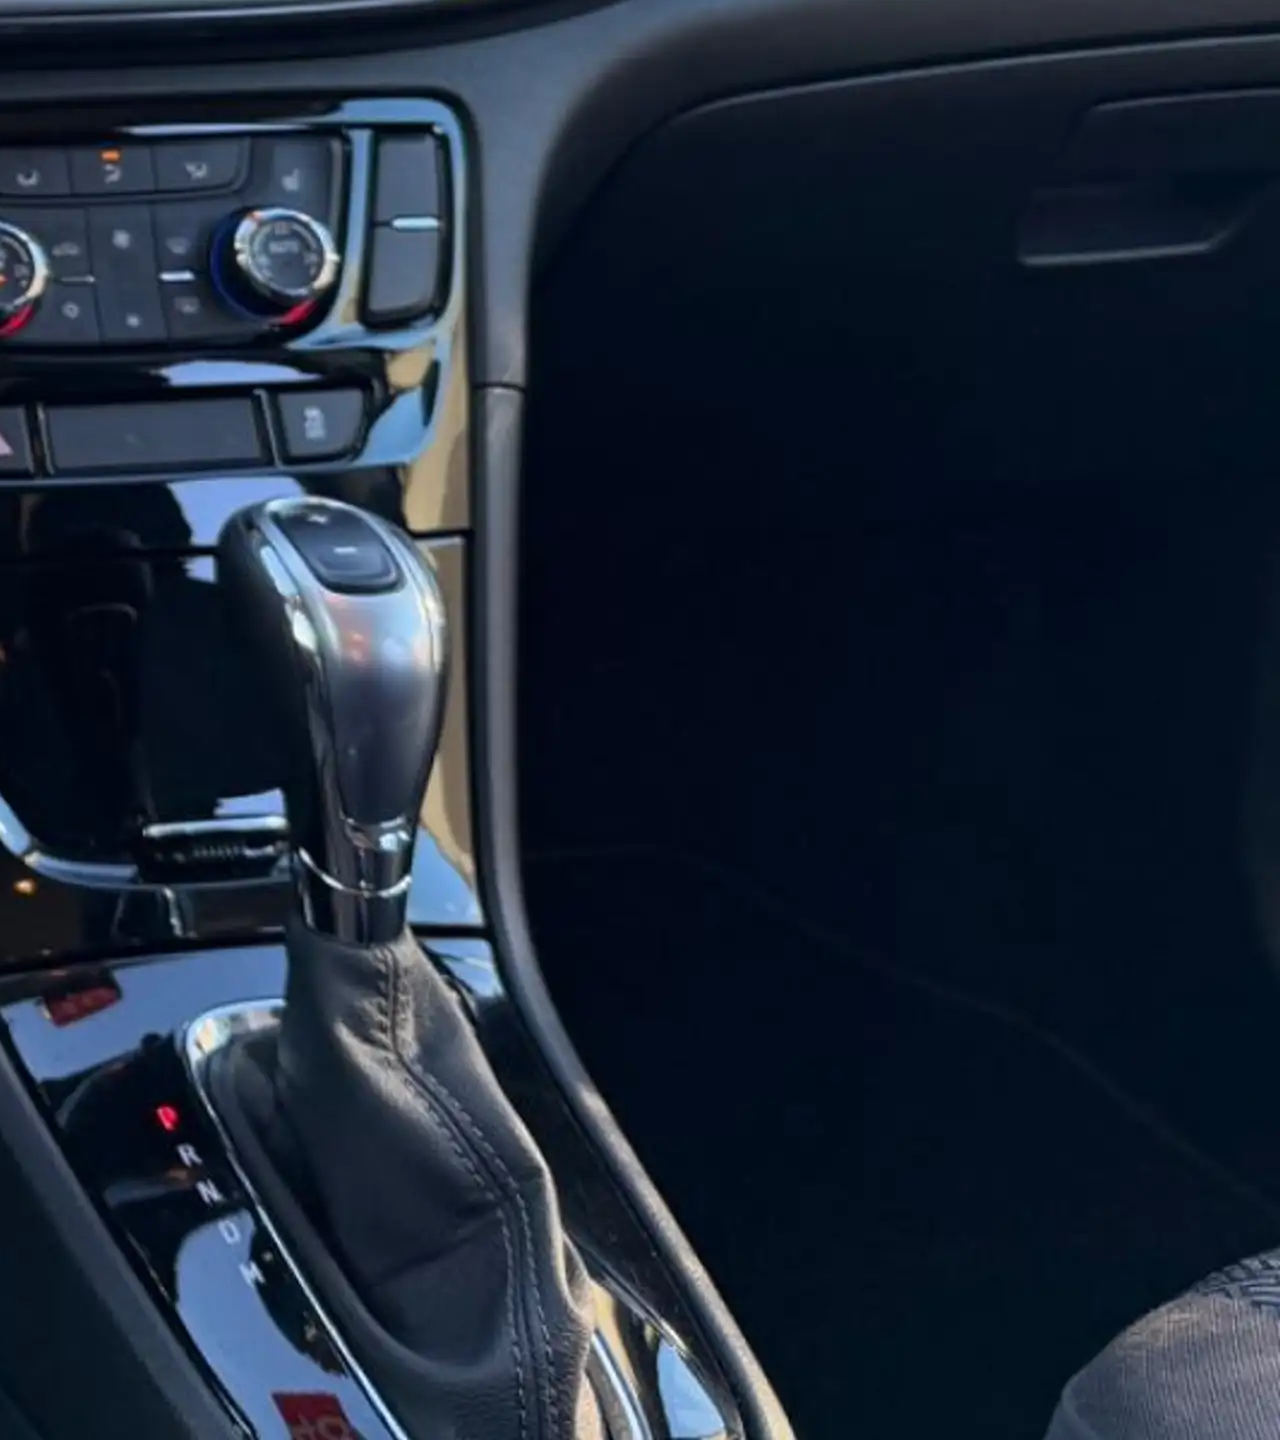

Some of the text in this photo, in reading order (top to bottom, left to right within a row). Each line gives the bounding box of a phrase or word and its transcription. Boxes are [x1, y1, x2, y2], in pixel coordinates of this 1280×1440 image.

[156, 1106, 179, 1131] P
[177, 1143, 202, 1167] R
[196, 1179, 225, 1204] N
[217, 1220, 241, 1245] D
[239, 1260, 266, 1287] M
